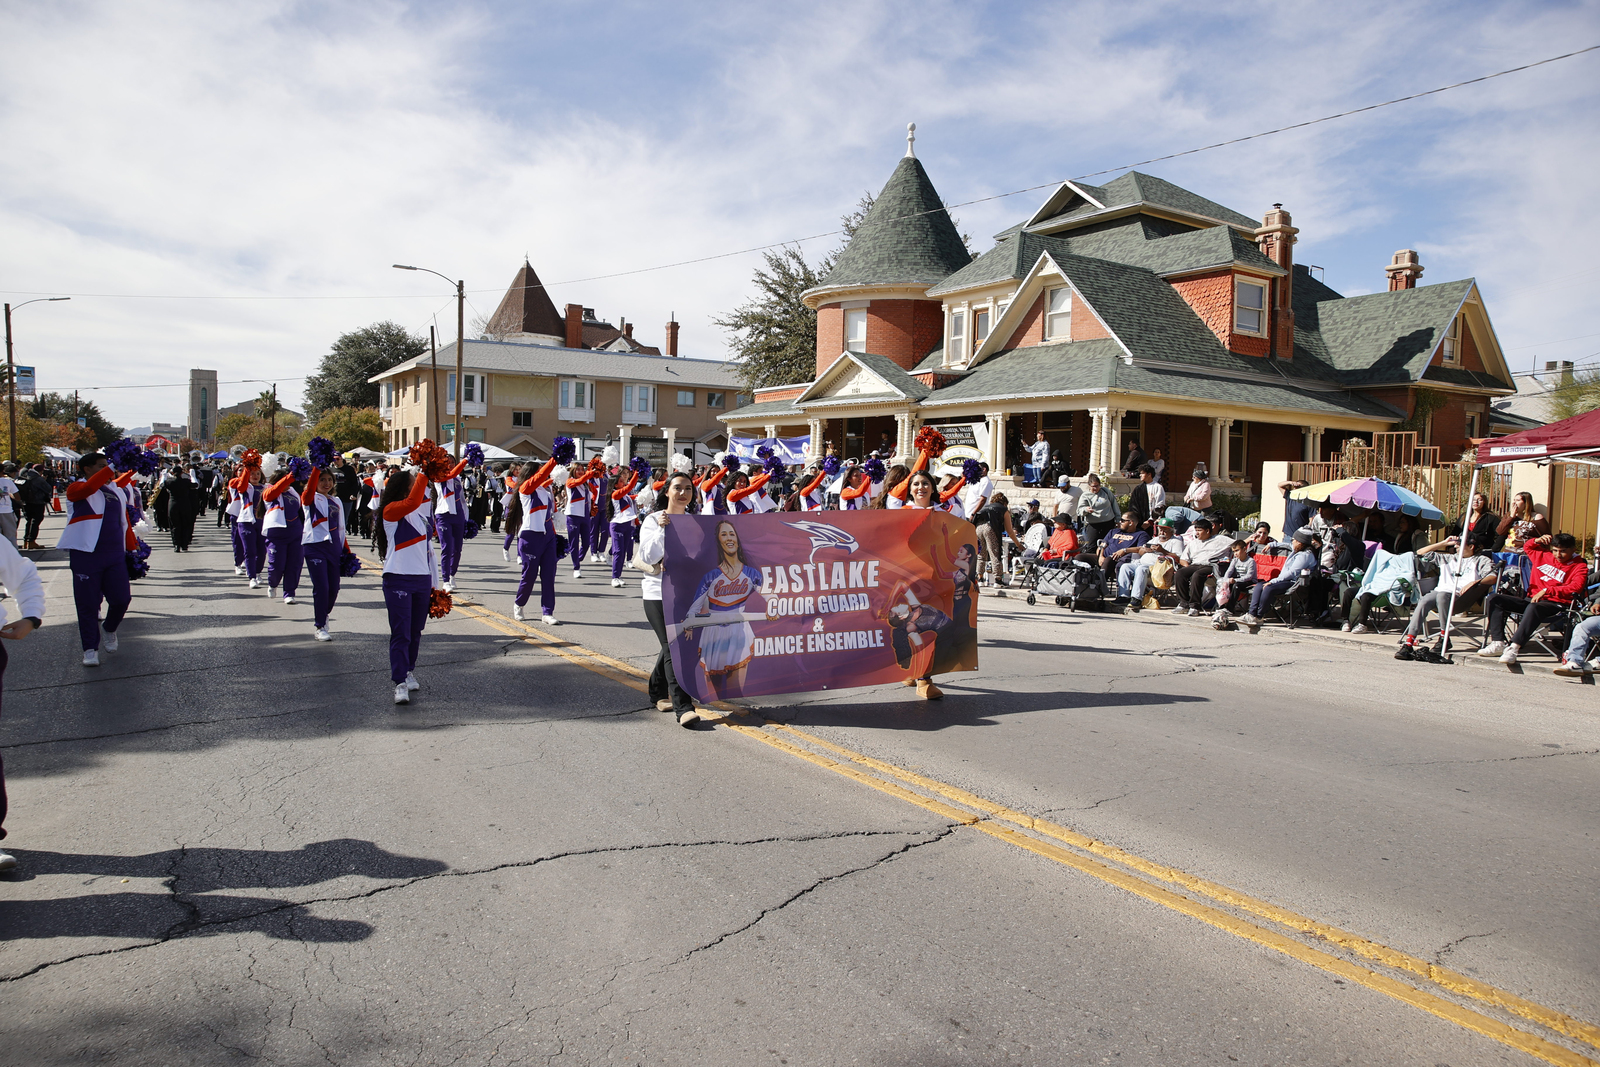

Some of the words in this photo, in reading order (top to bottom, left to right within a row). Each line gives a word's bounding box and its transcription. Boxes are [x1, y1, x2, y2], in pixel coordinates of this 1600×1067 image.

[760, 560, 880, 594] EASTLAKE
[767, 596, 816, 617] COLOR
[817, 592, 870, 614] GUARD
[812, 617, 825, 633] &
[753, 633, 805, 657] DANCE
[806, 629, 885, 653] ENSEMBLE
